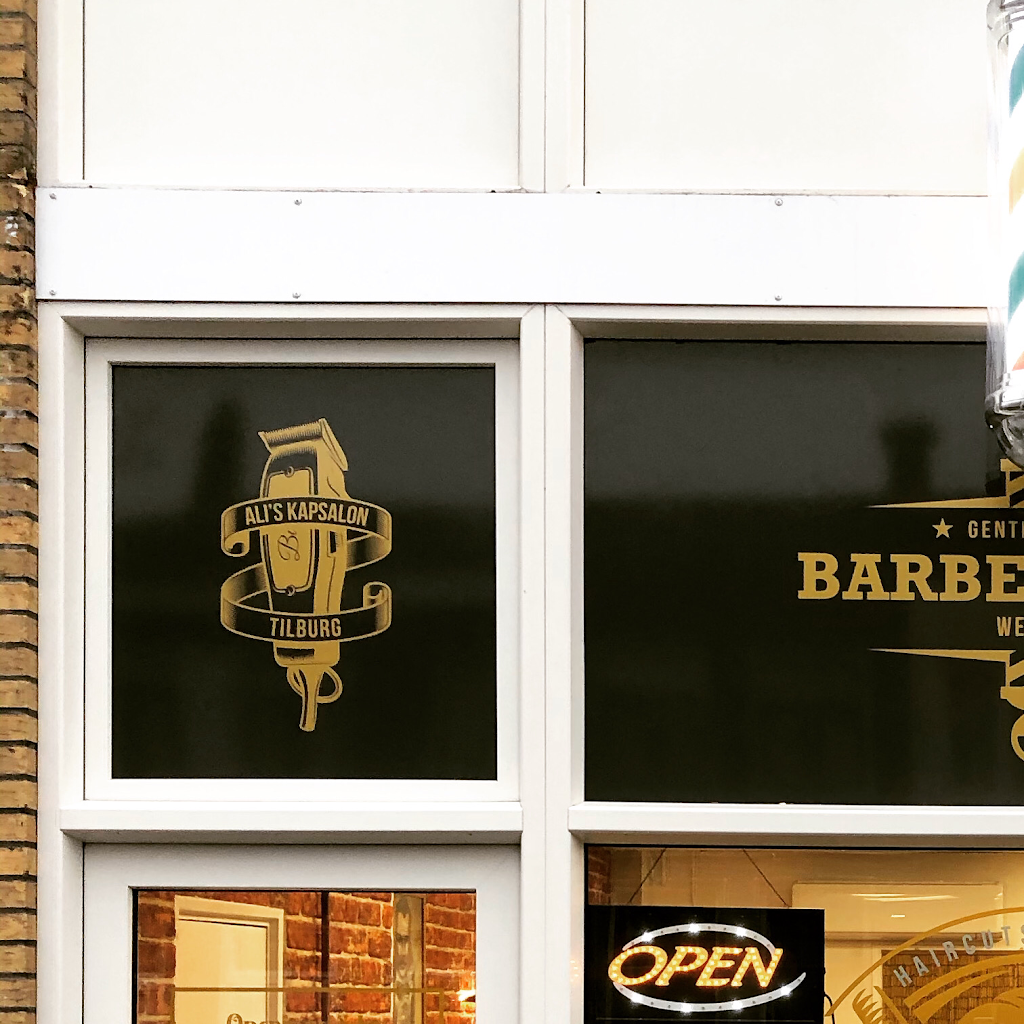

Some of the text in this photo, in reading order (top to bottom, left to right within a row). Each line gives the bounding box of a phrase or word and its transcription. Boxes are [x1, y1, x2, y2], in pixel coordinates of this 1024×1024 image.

[245, 501, 369, 527] ALI'S KAPSALON
[270, 617, 342, 638] TILBURG
[608, 945, 783, 987] OPEN
